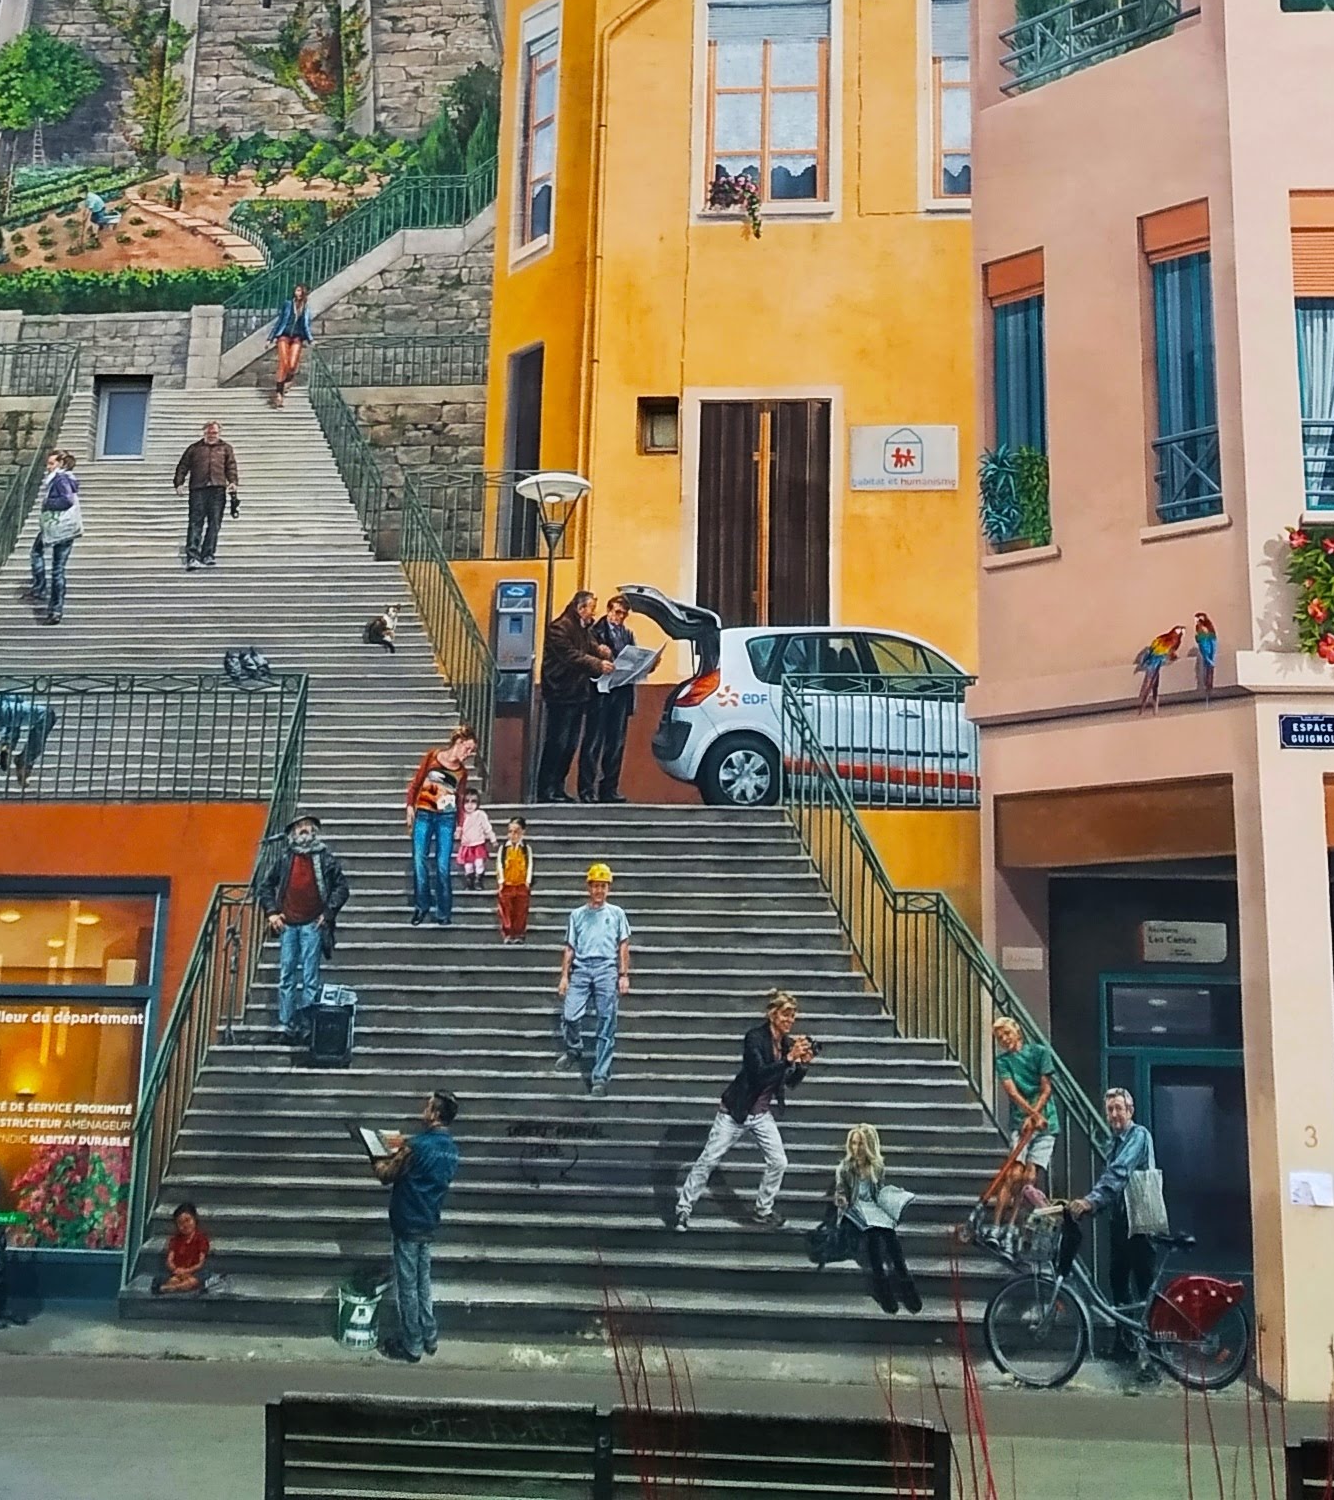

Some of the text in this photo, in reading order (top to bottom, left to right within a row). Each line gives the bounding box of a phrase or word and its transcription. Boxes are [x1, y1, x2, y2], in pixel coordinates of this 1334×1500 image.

[887, 478, 899, 486] et
[1292, 722, 1334, 732] ESPACE
[31, 1010, 50, 1024] du
[53, 1010, 144, 1026] département
[10, 1102, 25, 1112] DE
[27, 1103, 74, 1113] SERVICE
[74, 1103, 132, 1115] PROXIMITÉ
[29, 1135, 76, 1145] HABITAT
[78, 1135, 131, 1146] DURABLE
[1304, 1125, 1318, 1148] 3
